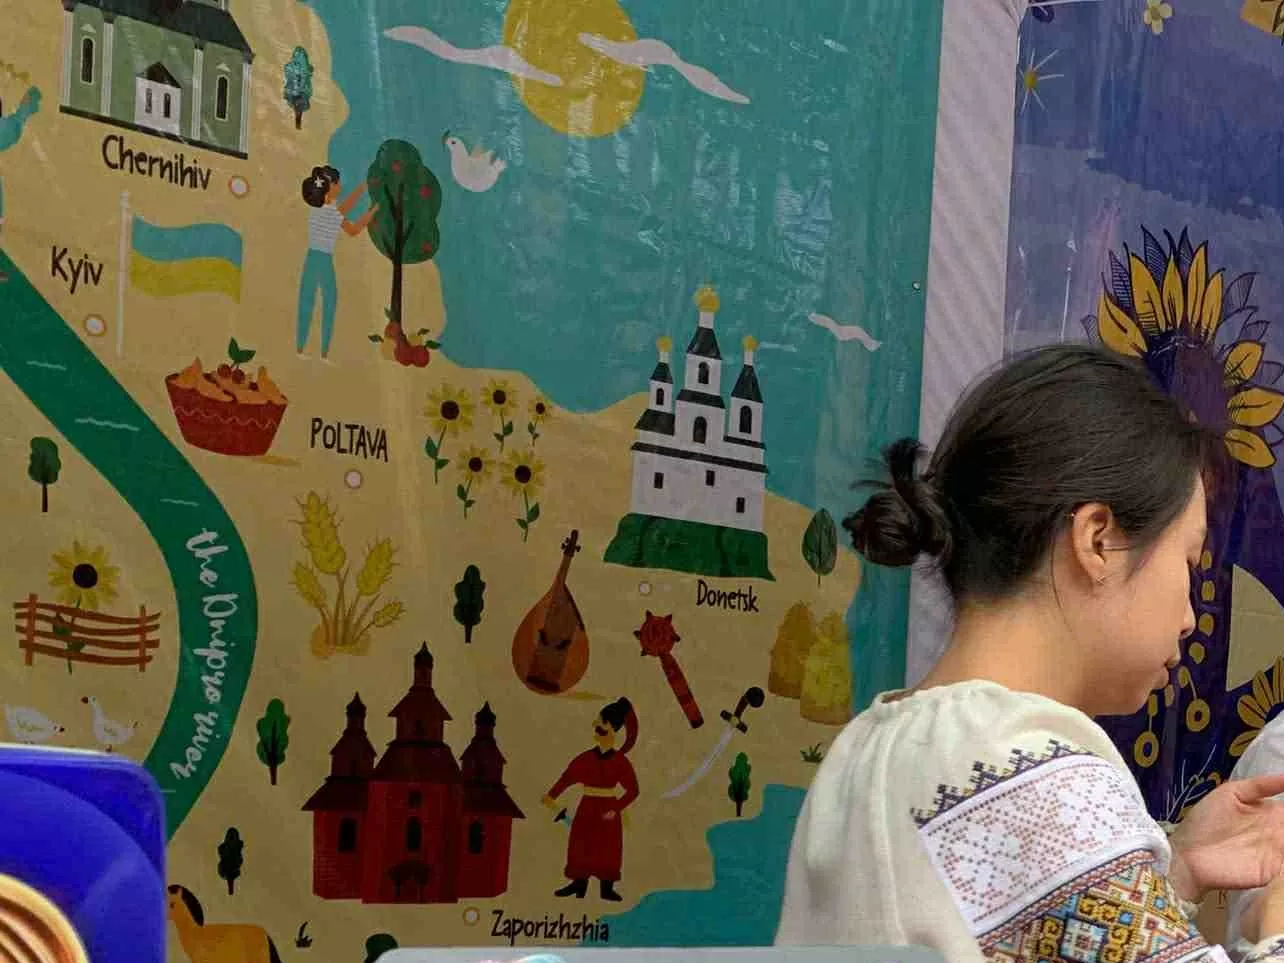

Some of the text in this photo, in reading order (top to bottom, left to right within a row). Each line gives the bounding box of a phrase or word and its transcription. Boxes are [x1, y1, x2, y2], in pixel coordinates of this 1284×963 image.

[102, 134, 212, 191] Chernihiv
[51, 246, 104, 294] Kyiv
[310, 417, 389, 463] POLTAVA
[185, 528, 229, 588] the
[696, 579, 760, 613] Donetsk
[169, 709, 222, 781] river
[490, 909, 609, 945] Zaporizhzhia
